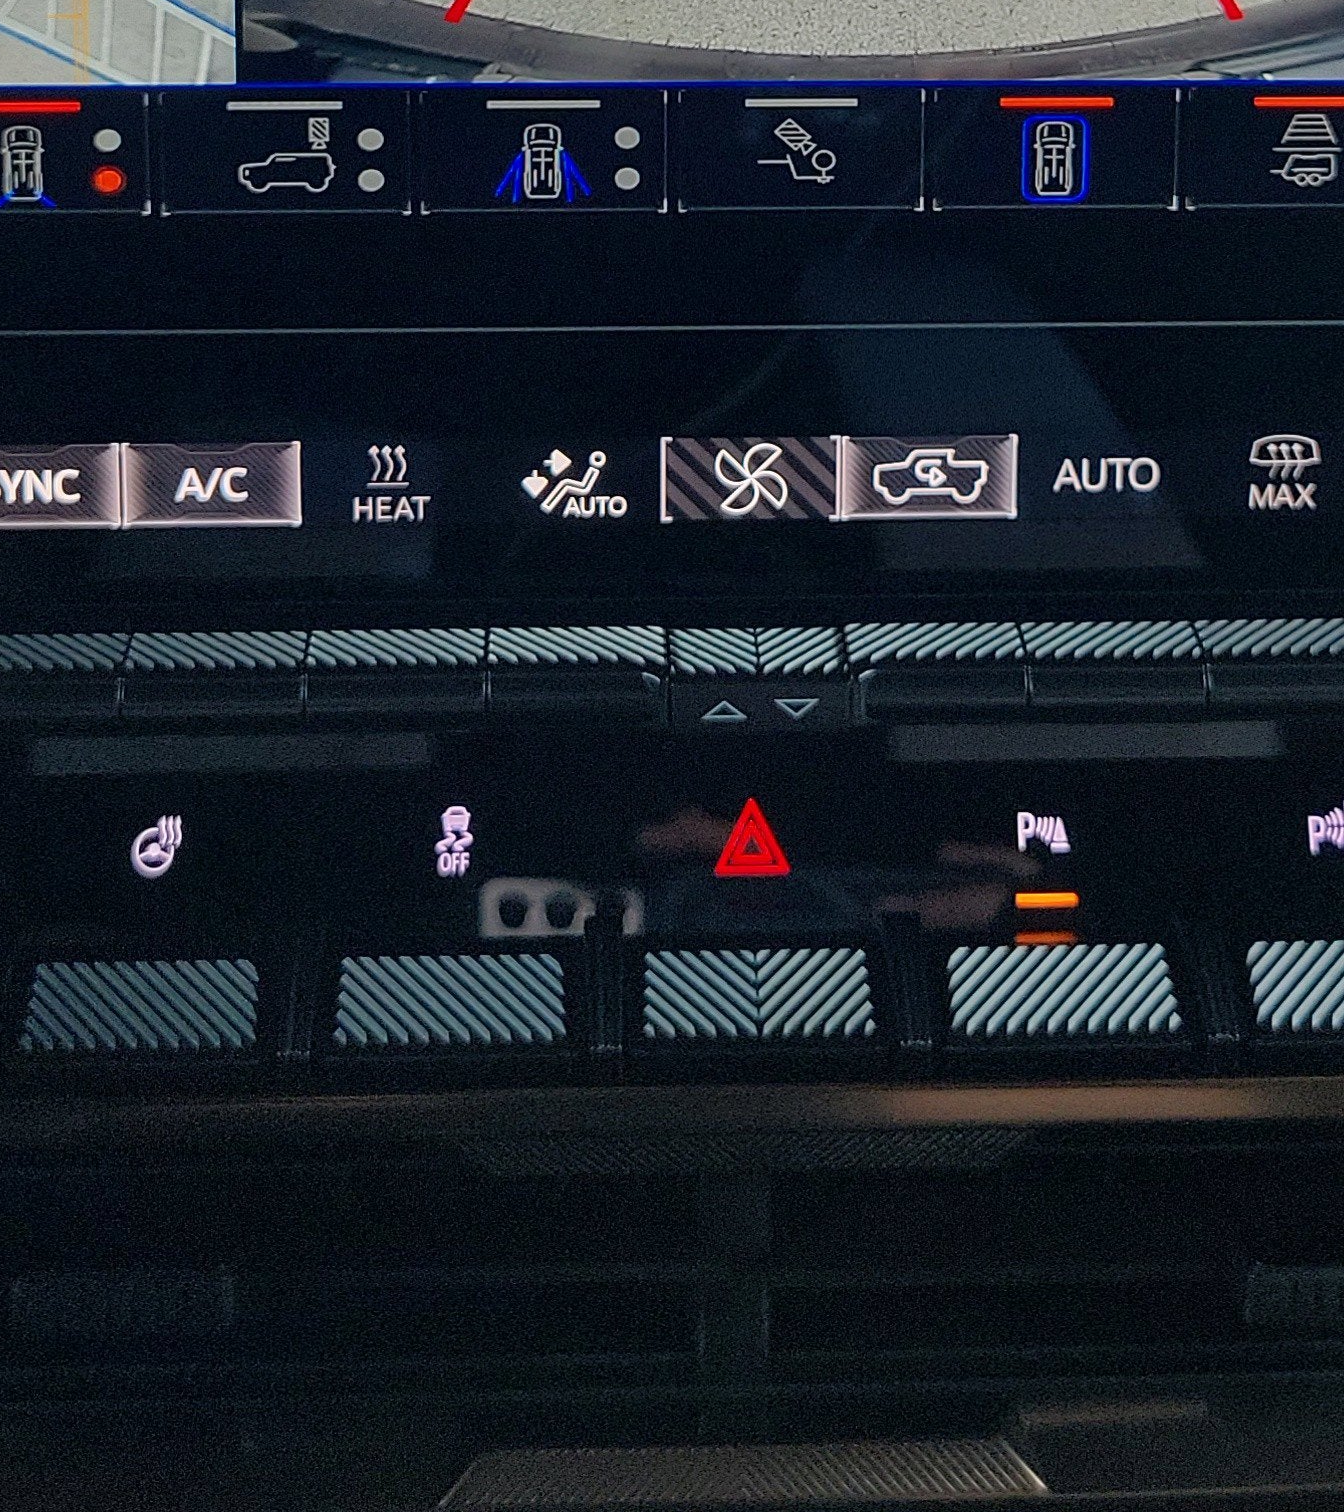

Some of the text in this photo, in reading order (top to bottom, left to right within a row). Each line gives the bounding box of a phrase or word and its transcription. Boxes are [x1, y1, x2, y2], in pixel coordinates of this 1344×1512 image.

[173, 466, 250, 505] A/C
[1052, 455, 1162, 494] AUTO
[351, 491, 432, 525] HEAT
[561, 493, 629, 519] AUTO
[1248, 481, 1318, 511] MAX
[437, 852, 471, 877] OFF
